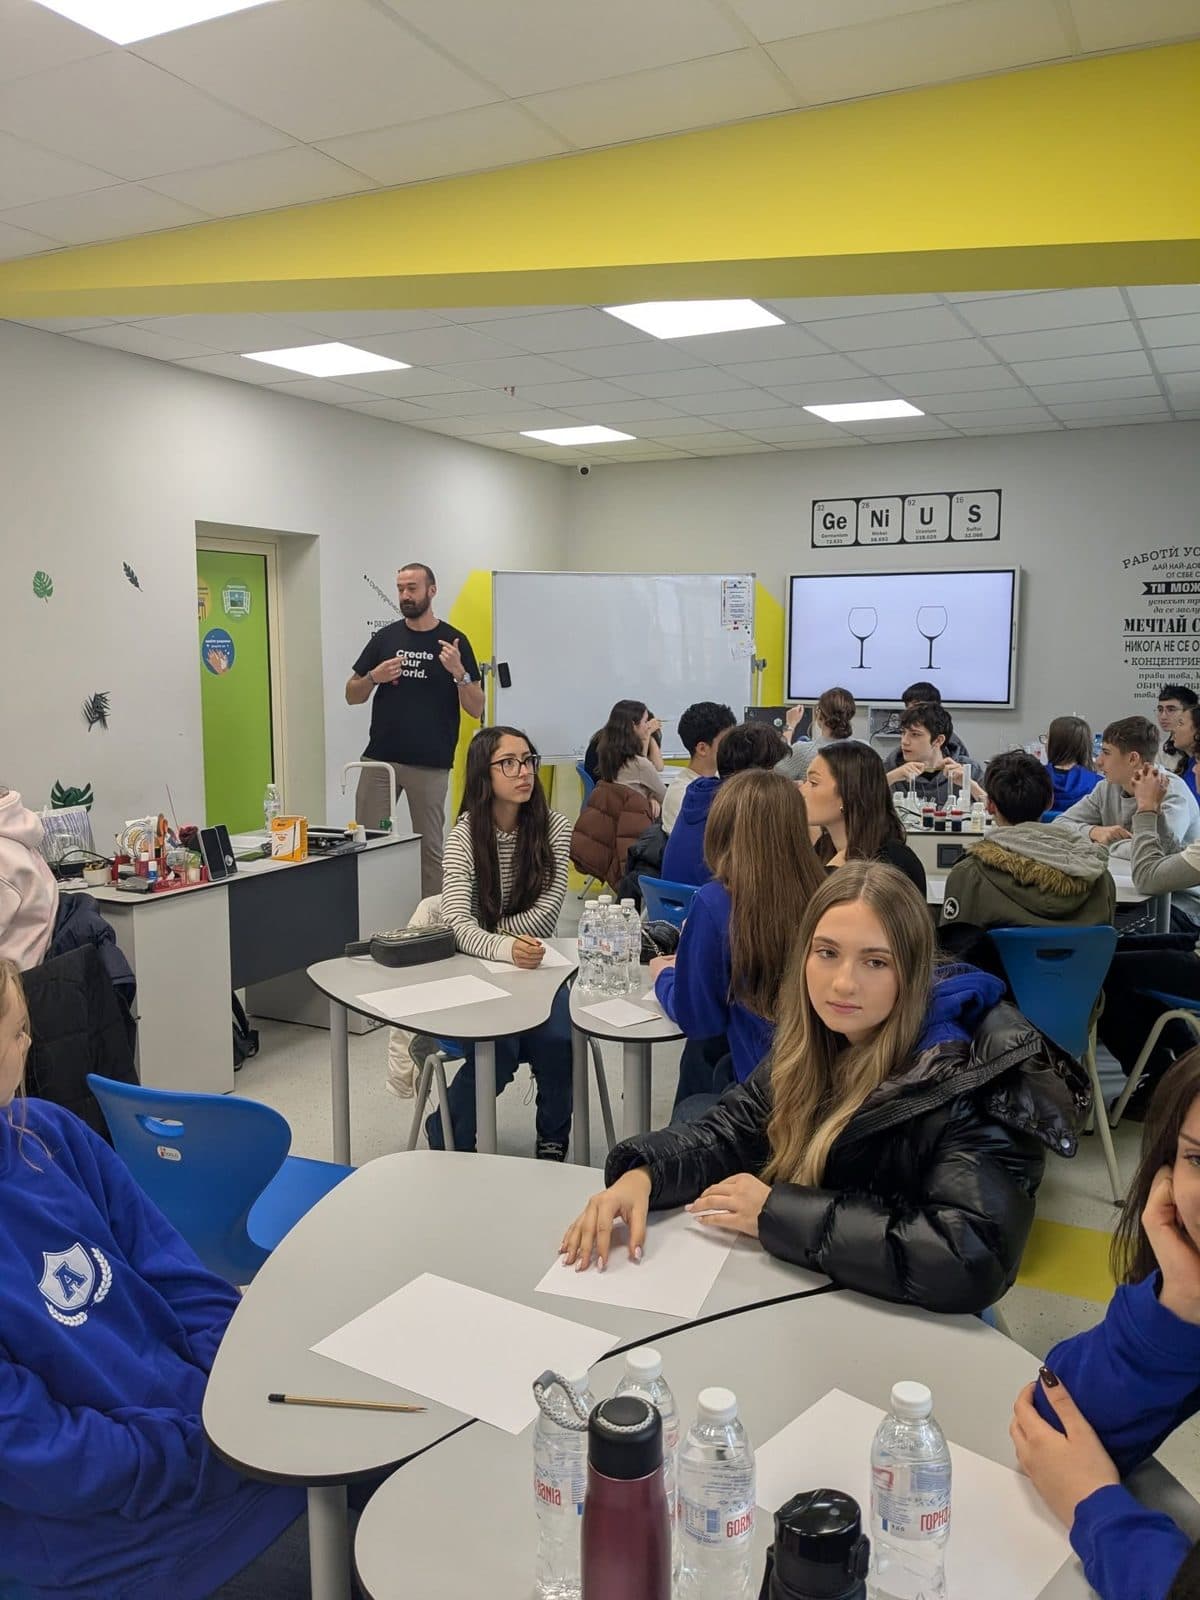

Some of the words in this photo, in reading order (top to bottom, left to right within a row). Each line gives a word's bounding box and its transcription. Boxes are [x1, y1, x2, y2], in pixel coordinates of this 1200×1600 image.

[822, 512, 848, 530] Ge
[871, 509, 889, 528] Ni
[920, 506, 934, 525] U
[967, 504, 982, 523] S
[1150, 583, 1166, 593] ТИ
[1124, 615, 1187, 632] МЕЧТАЙ
[1191, 618, 1200, 632] С
[1124, 640, 1161, 652] НИКОГА
[1164, 640, 1175, 652] НЕ
[1177, 640, 1190, 652] СЕ
[1192, 640, 1200, 652] О
[396, 649, 434, 660] Create
[401, 659, 421, 667] our
[400, 668, 428, 679] orld.
[53, 1261, 88, 1303] A
